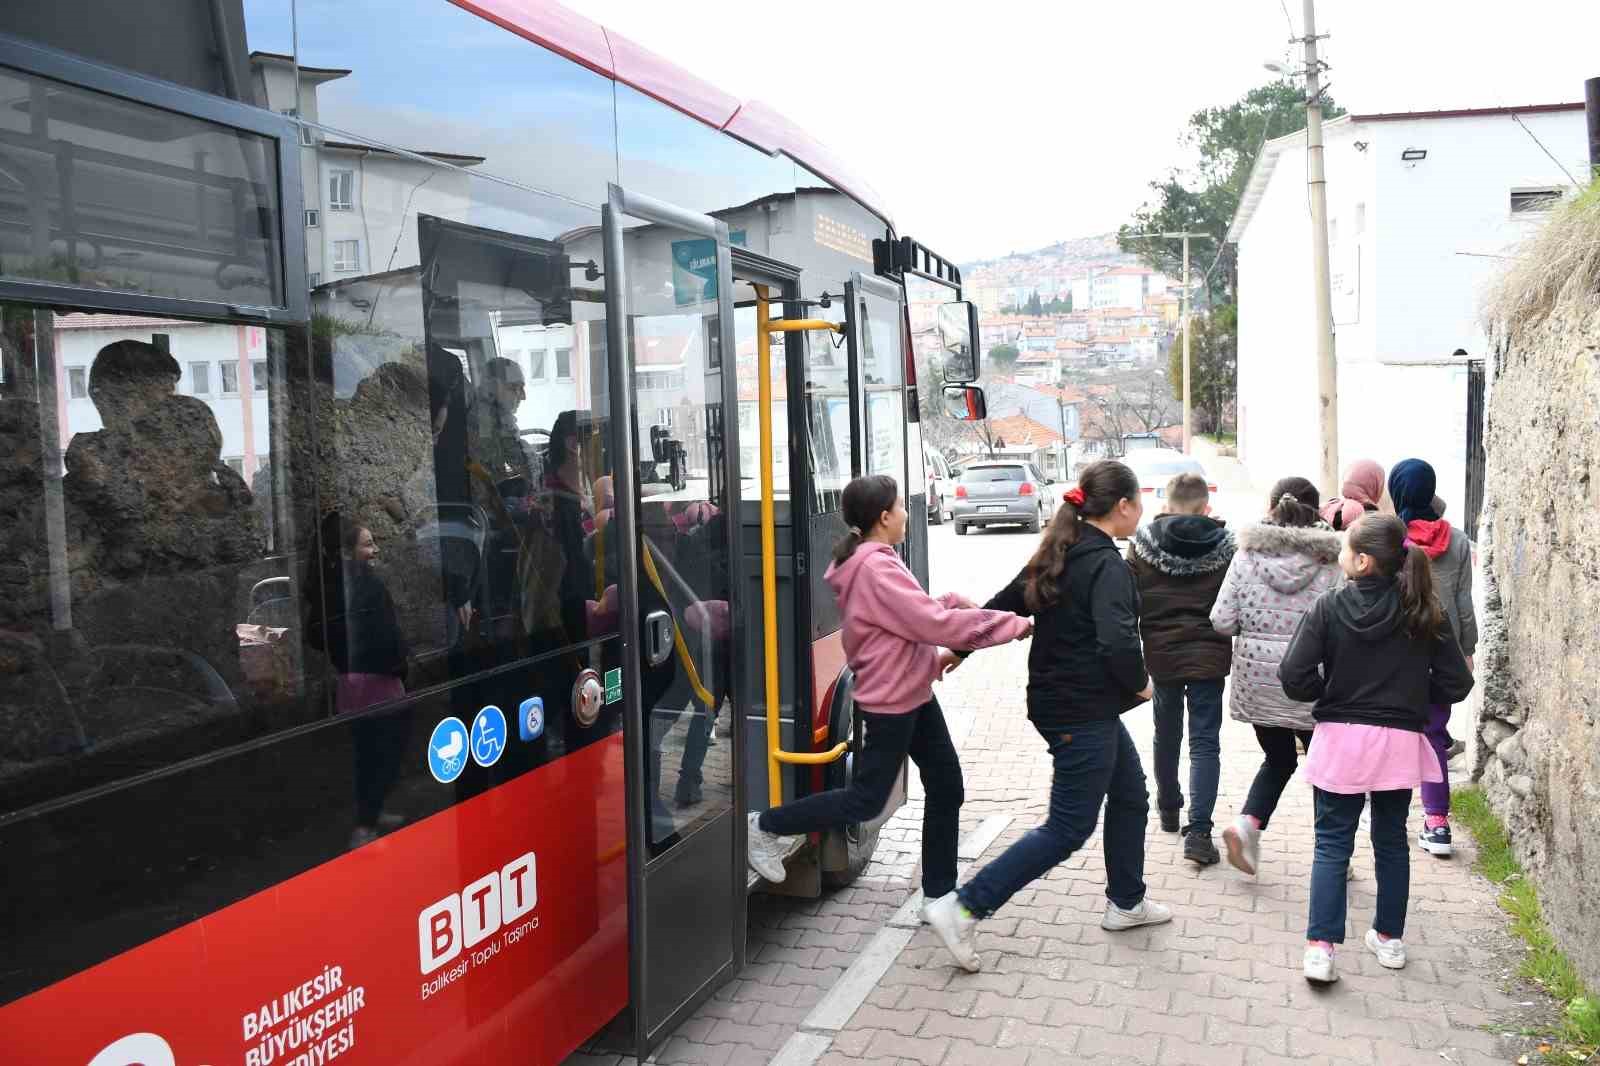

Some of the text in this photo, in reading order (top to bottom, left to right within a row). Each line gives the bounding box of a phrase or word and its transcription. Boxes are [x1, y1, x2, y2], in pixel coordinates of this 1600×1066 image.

[428, 862, 530, 962] BTT
[421, 916, 540, 1001] Balıkesir Toplu Taşıma
[243, 964, 343, 1042] BALIKESİR
[245, 985, 366, 1066] BÜYÜKŞEHİR
